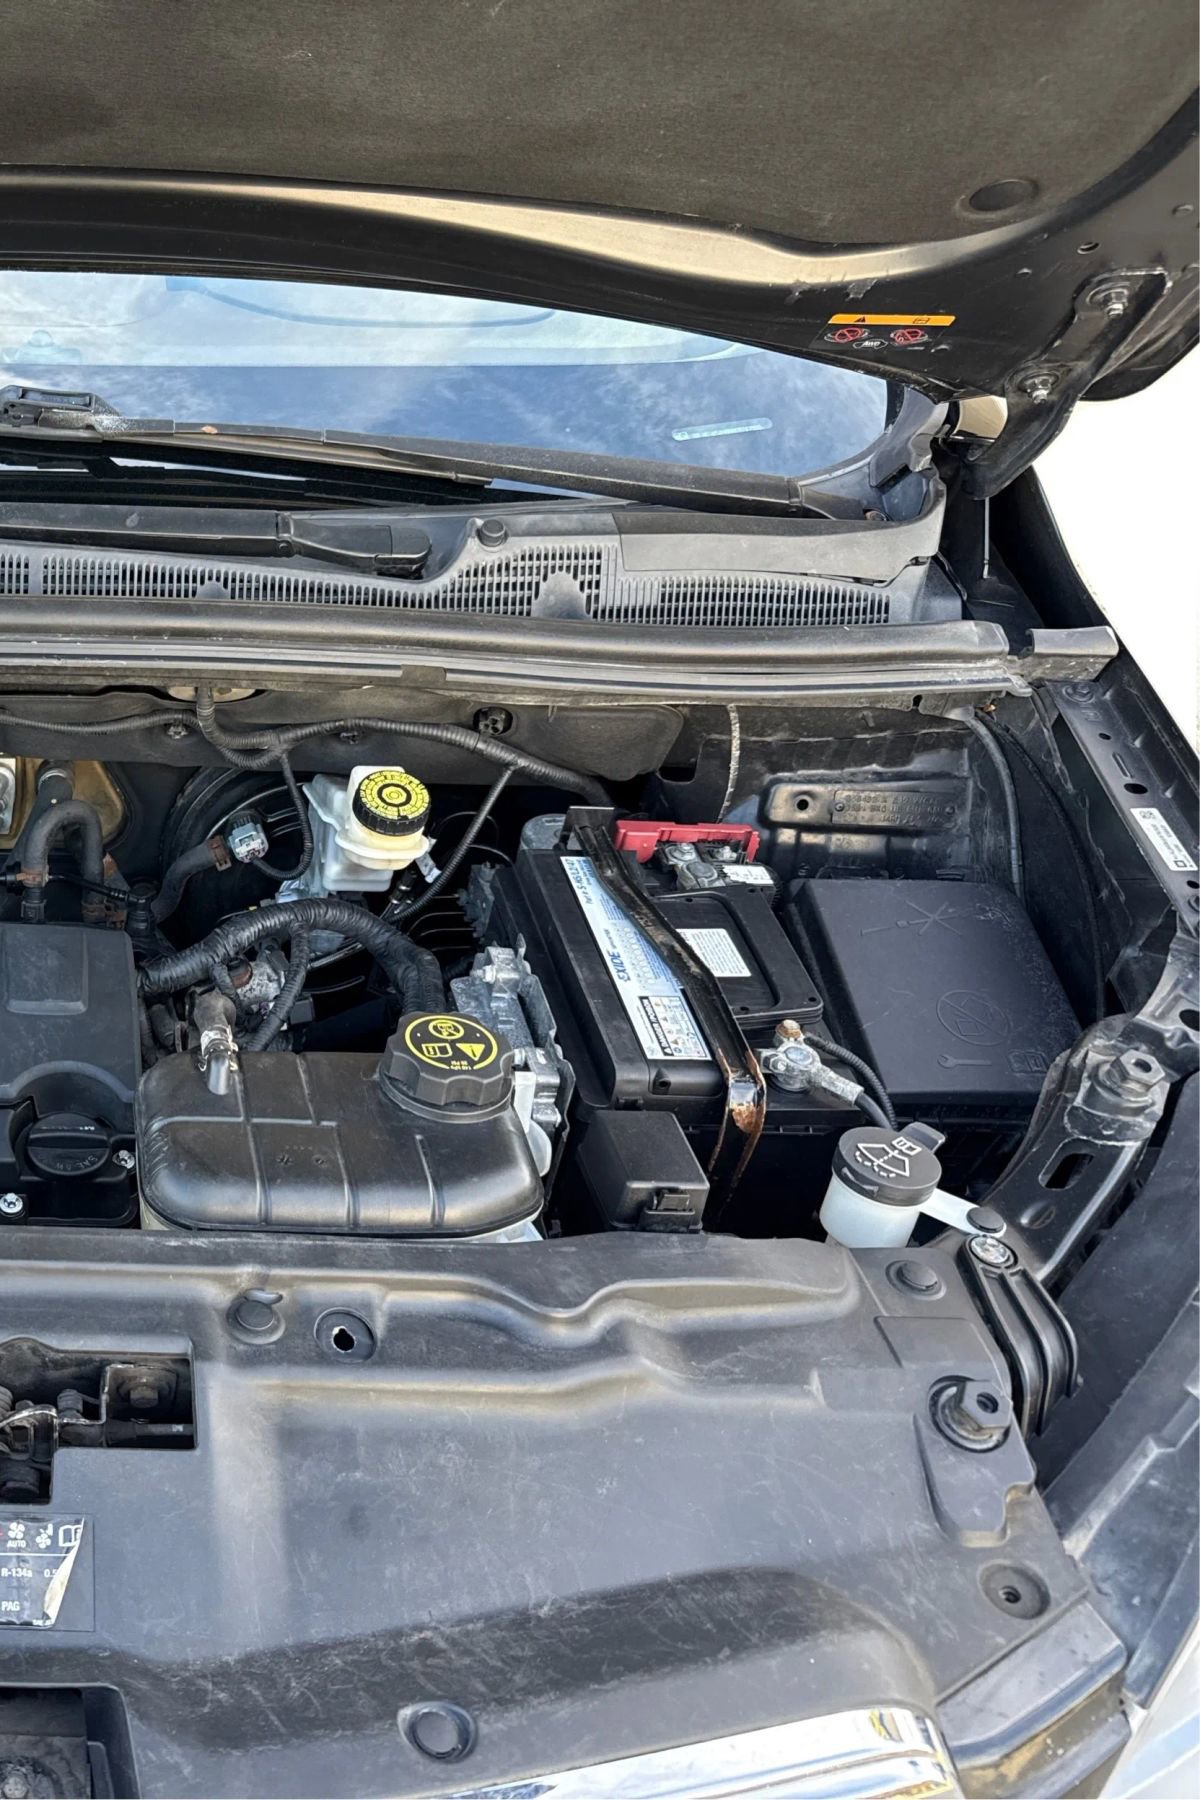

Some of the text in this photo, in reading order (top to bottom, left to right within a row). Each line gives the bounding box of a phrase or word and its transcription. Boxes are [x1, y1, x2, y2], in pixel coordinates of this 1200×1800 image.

[605, 948, 631, 983] EXIDE
[6, 1540, 27, 1548] AUTO
[1, 1567, 33, 1578] R-134a
[1, 1601, 21, 1611] PAG
